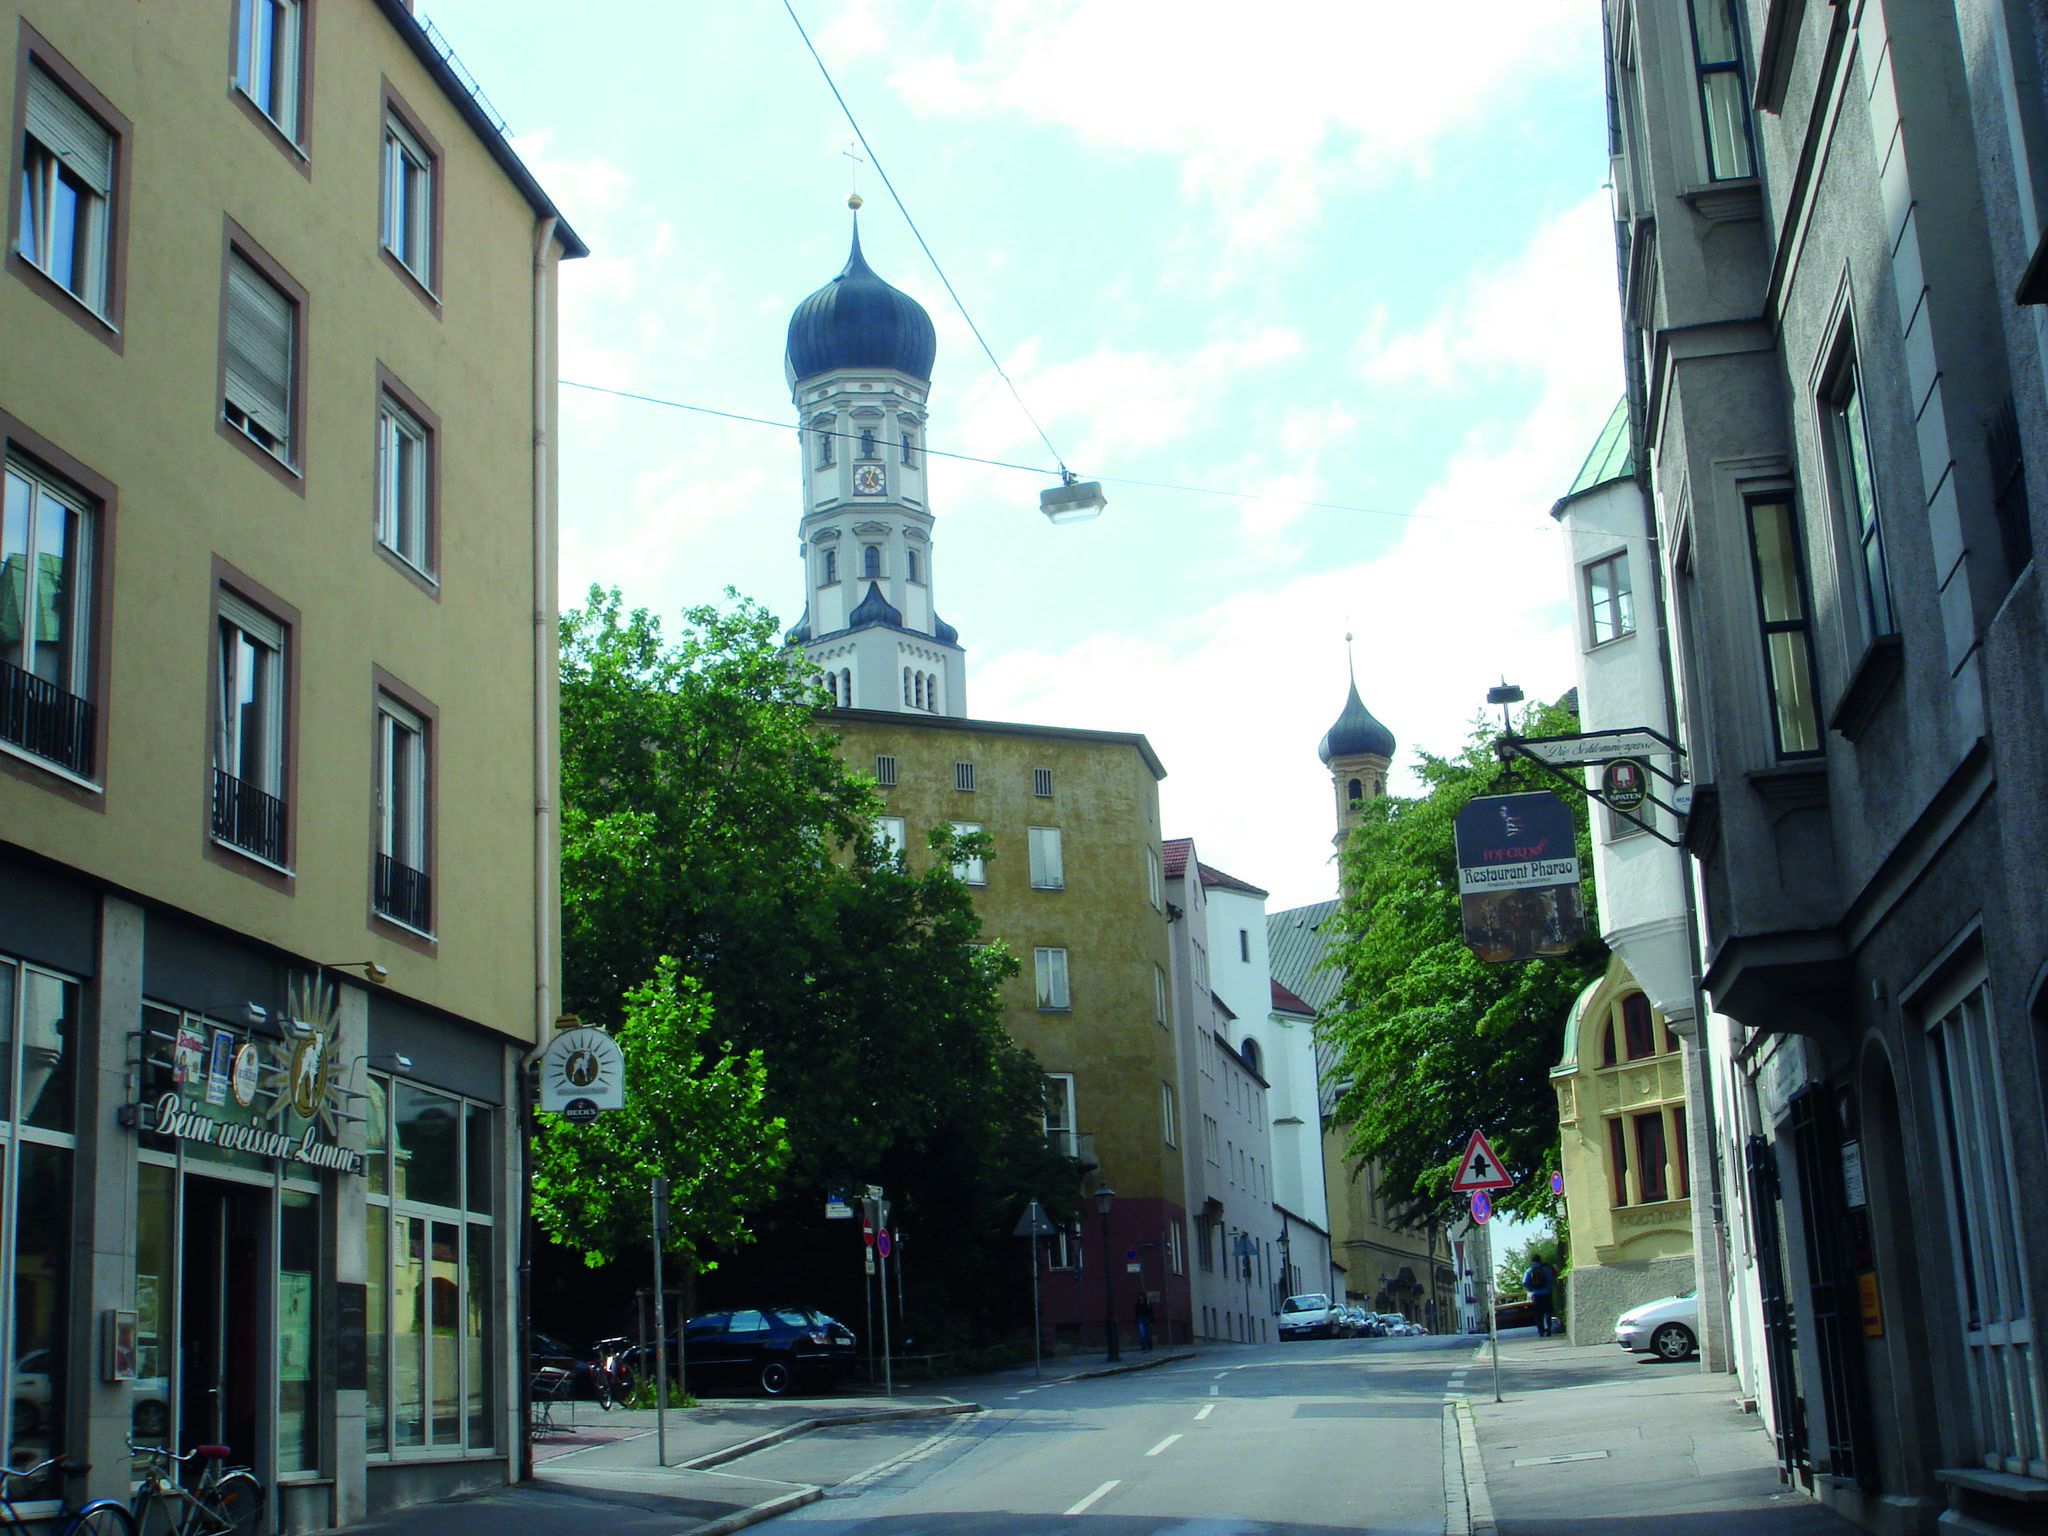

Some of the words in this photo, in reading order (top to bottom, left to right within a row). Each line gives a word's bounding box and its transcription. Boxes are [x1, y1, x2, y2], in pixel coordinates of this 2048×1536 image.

[1547, 745, 1568, 757] Die
[1609, 792, 1642, 802] SPATEN
[1464, 864, 1528, 884] Restaurant
[1531, 862, 1573, 877] Pharao
[566, 1108, 597, 1116] BECK'S
[155, 1092, 214, 1143] Beim
[218, 1116, 291, 1159] weissen
[294, 1126, 355, 1172] Lamm
